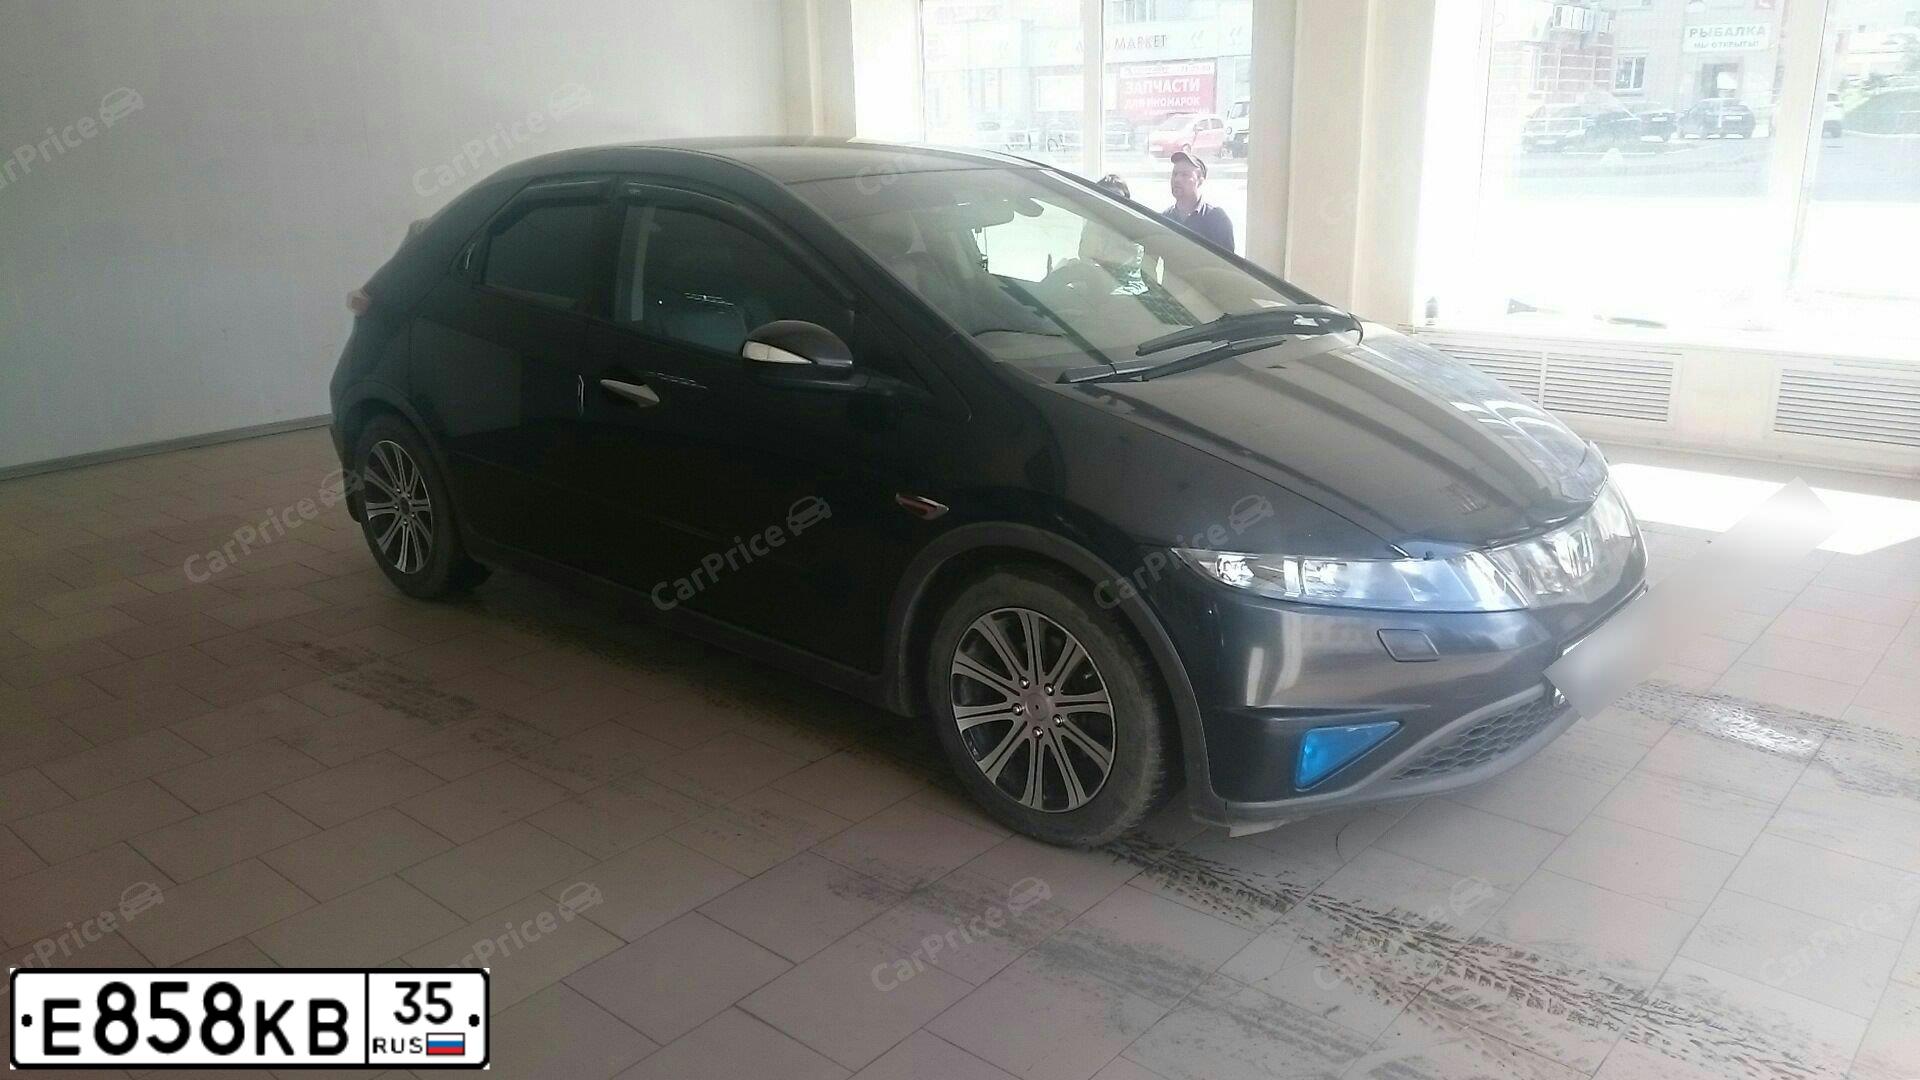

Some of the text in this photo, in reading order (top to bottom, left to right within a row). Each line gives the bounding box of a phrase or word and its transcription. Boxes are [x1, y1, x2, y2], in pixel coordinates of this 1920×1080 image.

[1689, 25, 1766, 38] РЫБАЛКА
[1124, 78, 1200, 95] ЗАПЧАСТИ
[1147, 95, 1200, 108] ИНОМАРОК
